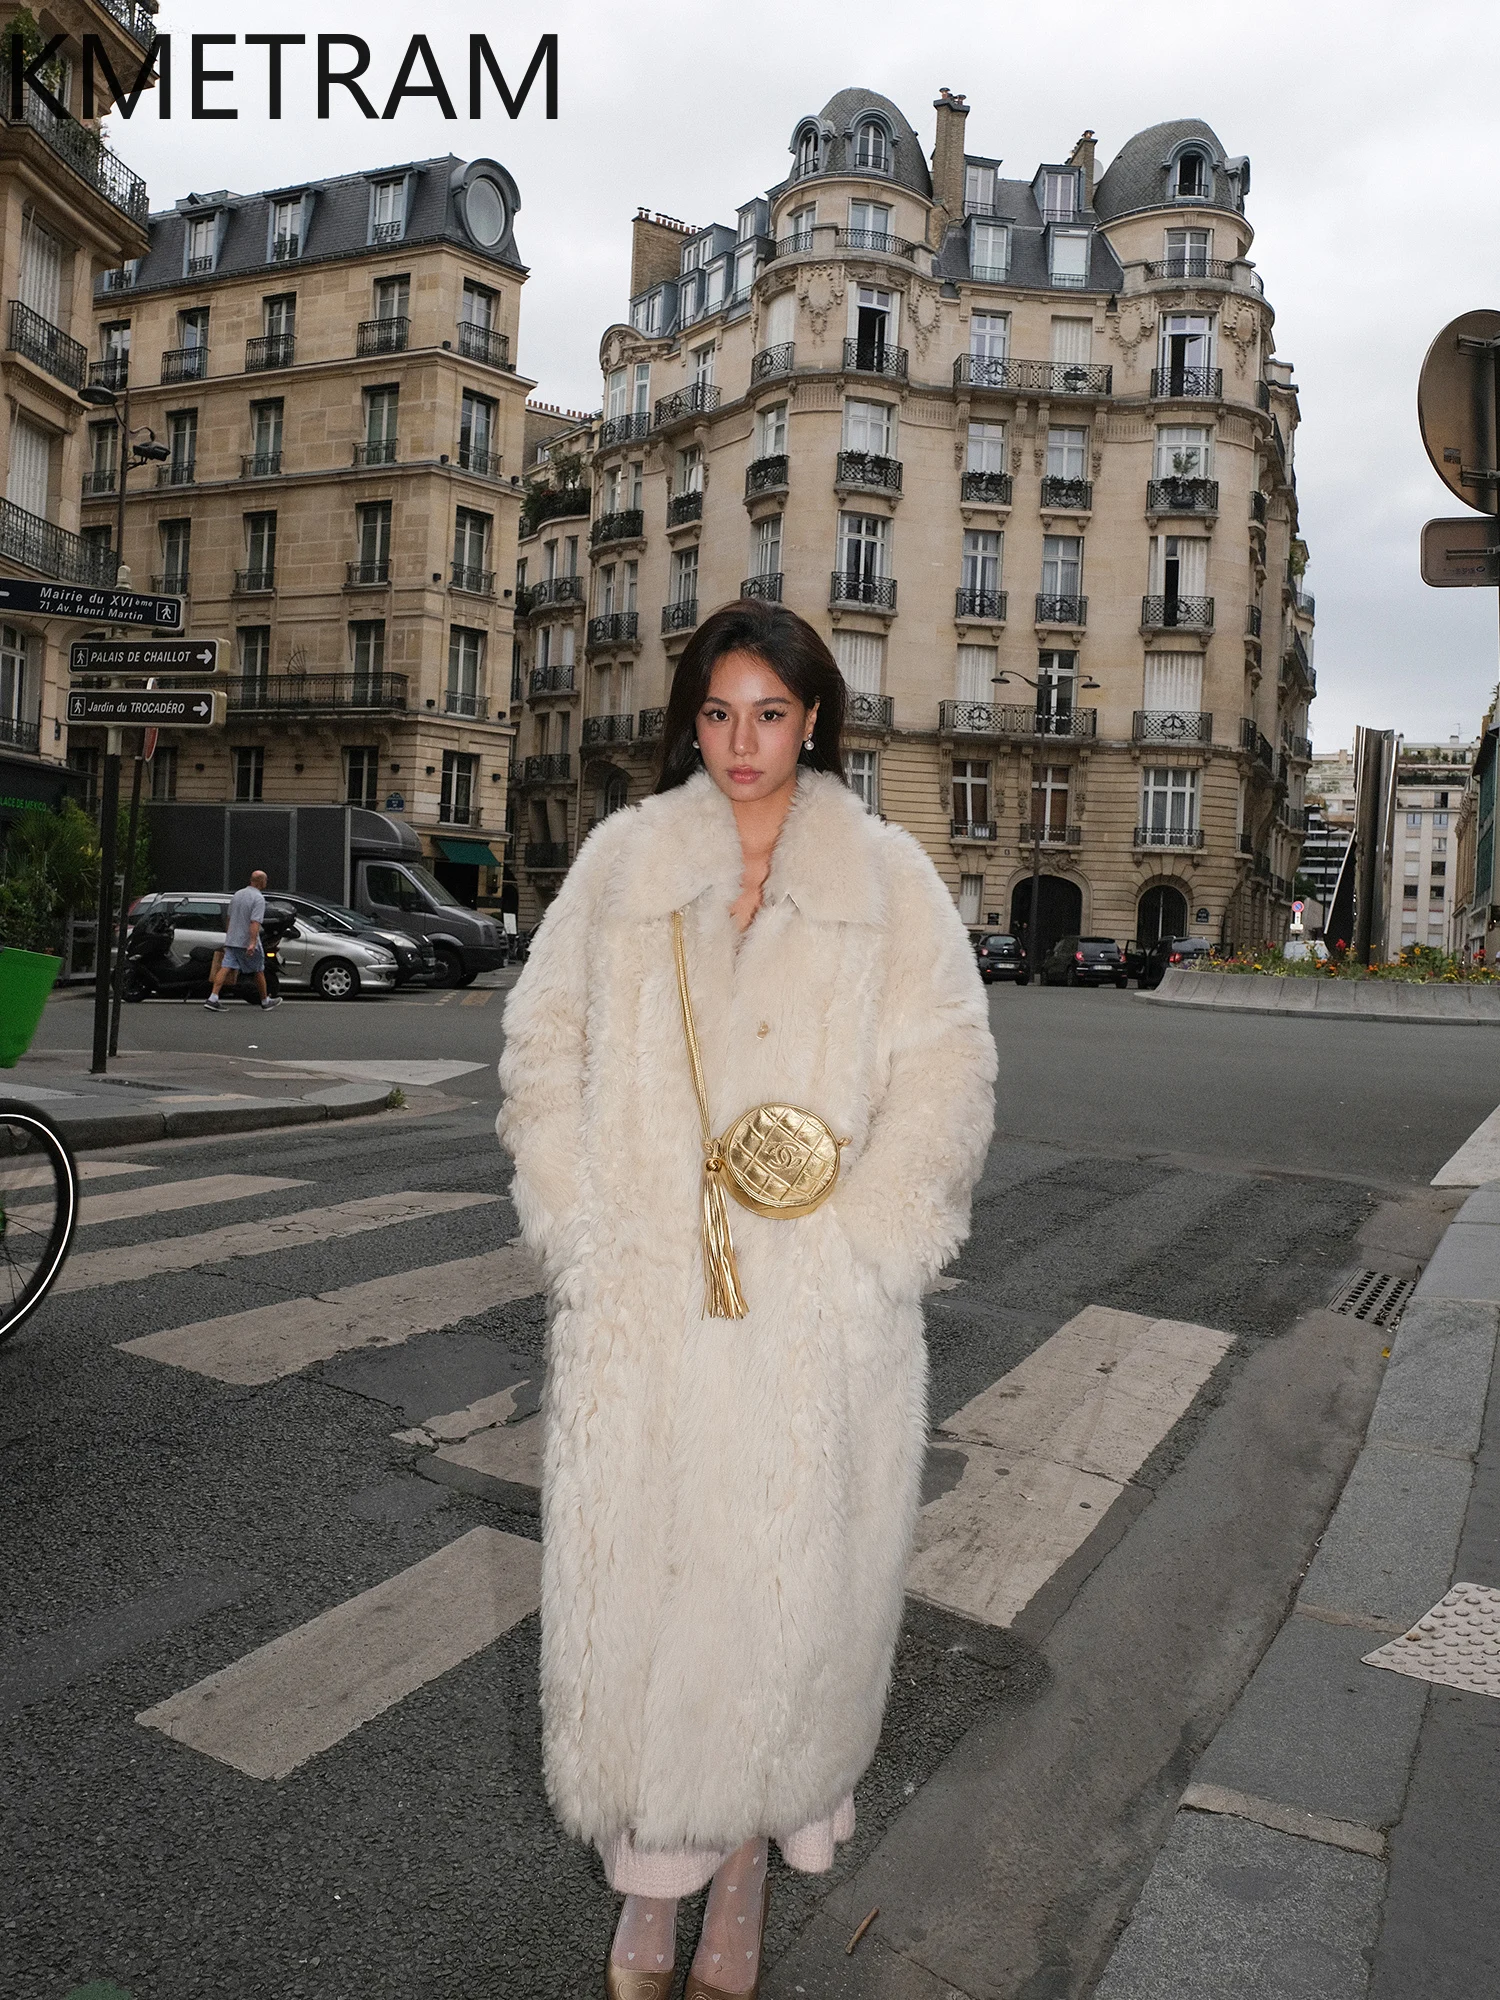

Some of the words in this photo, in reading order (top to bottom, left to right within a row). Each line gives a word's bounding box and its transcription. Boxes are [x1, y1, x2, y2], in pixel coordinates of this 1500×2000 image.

[39, 586, 83, 603] Mairie
[89, 592, 104, 604] du
[56, 603, 72, 613] Av.
[75, 604, 104, 616] Henri
[108, 609, 143, 621] Martin
[90, 651, 124, 663] PALAIS
[127, 651, 141, 663] DE
[143, 650, 191, 662] CHAILLOT
[87, 701, 114, 713] Jardin
[116, 702, 127, 713] du
[130, 700, 185, 714] TROCADÉRO
